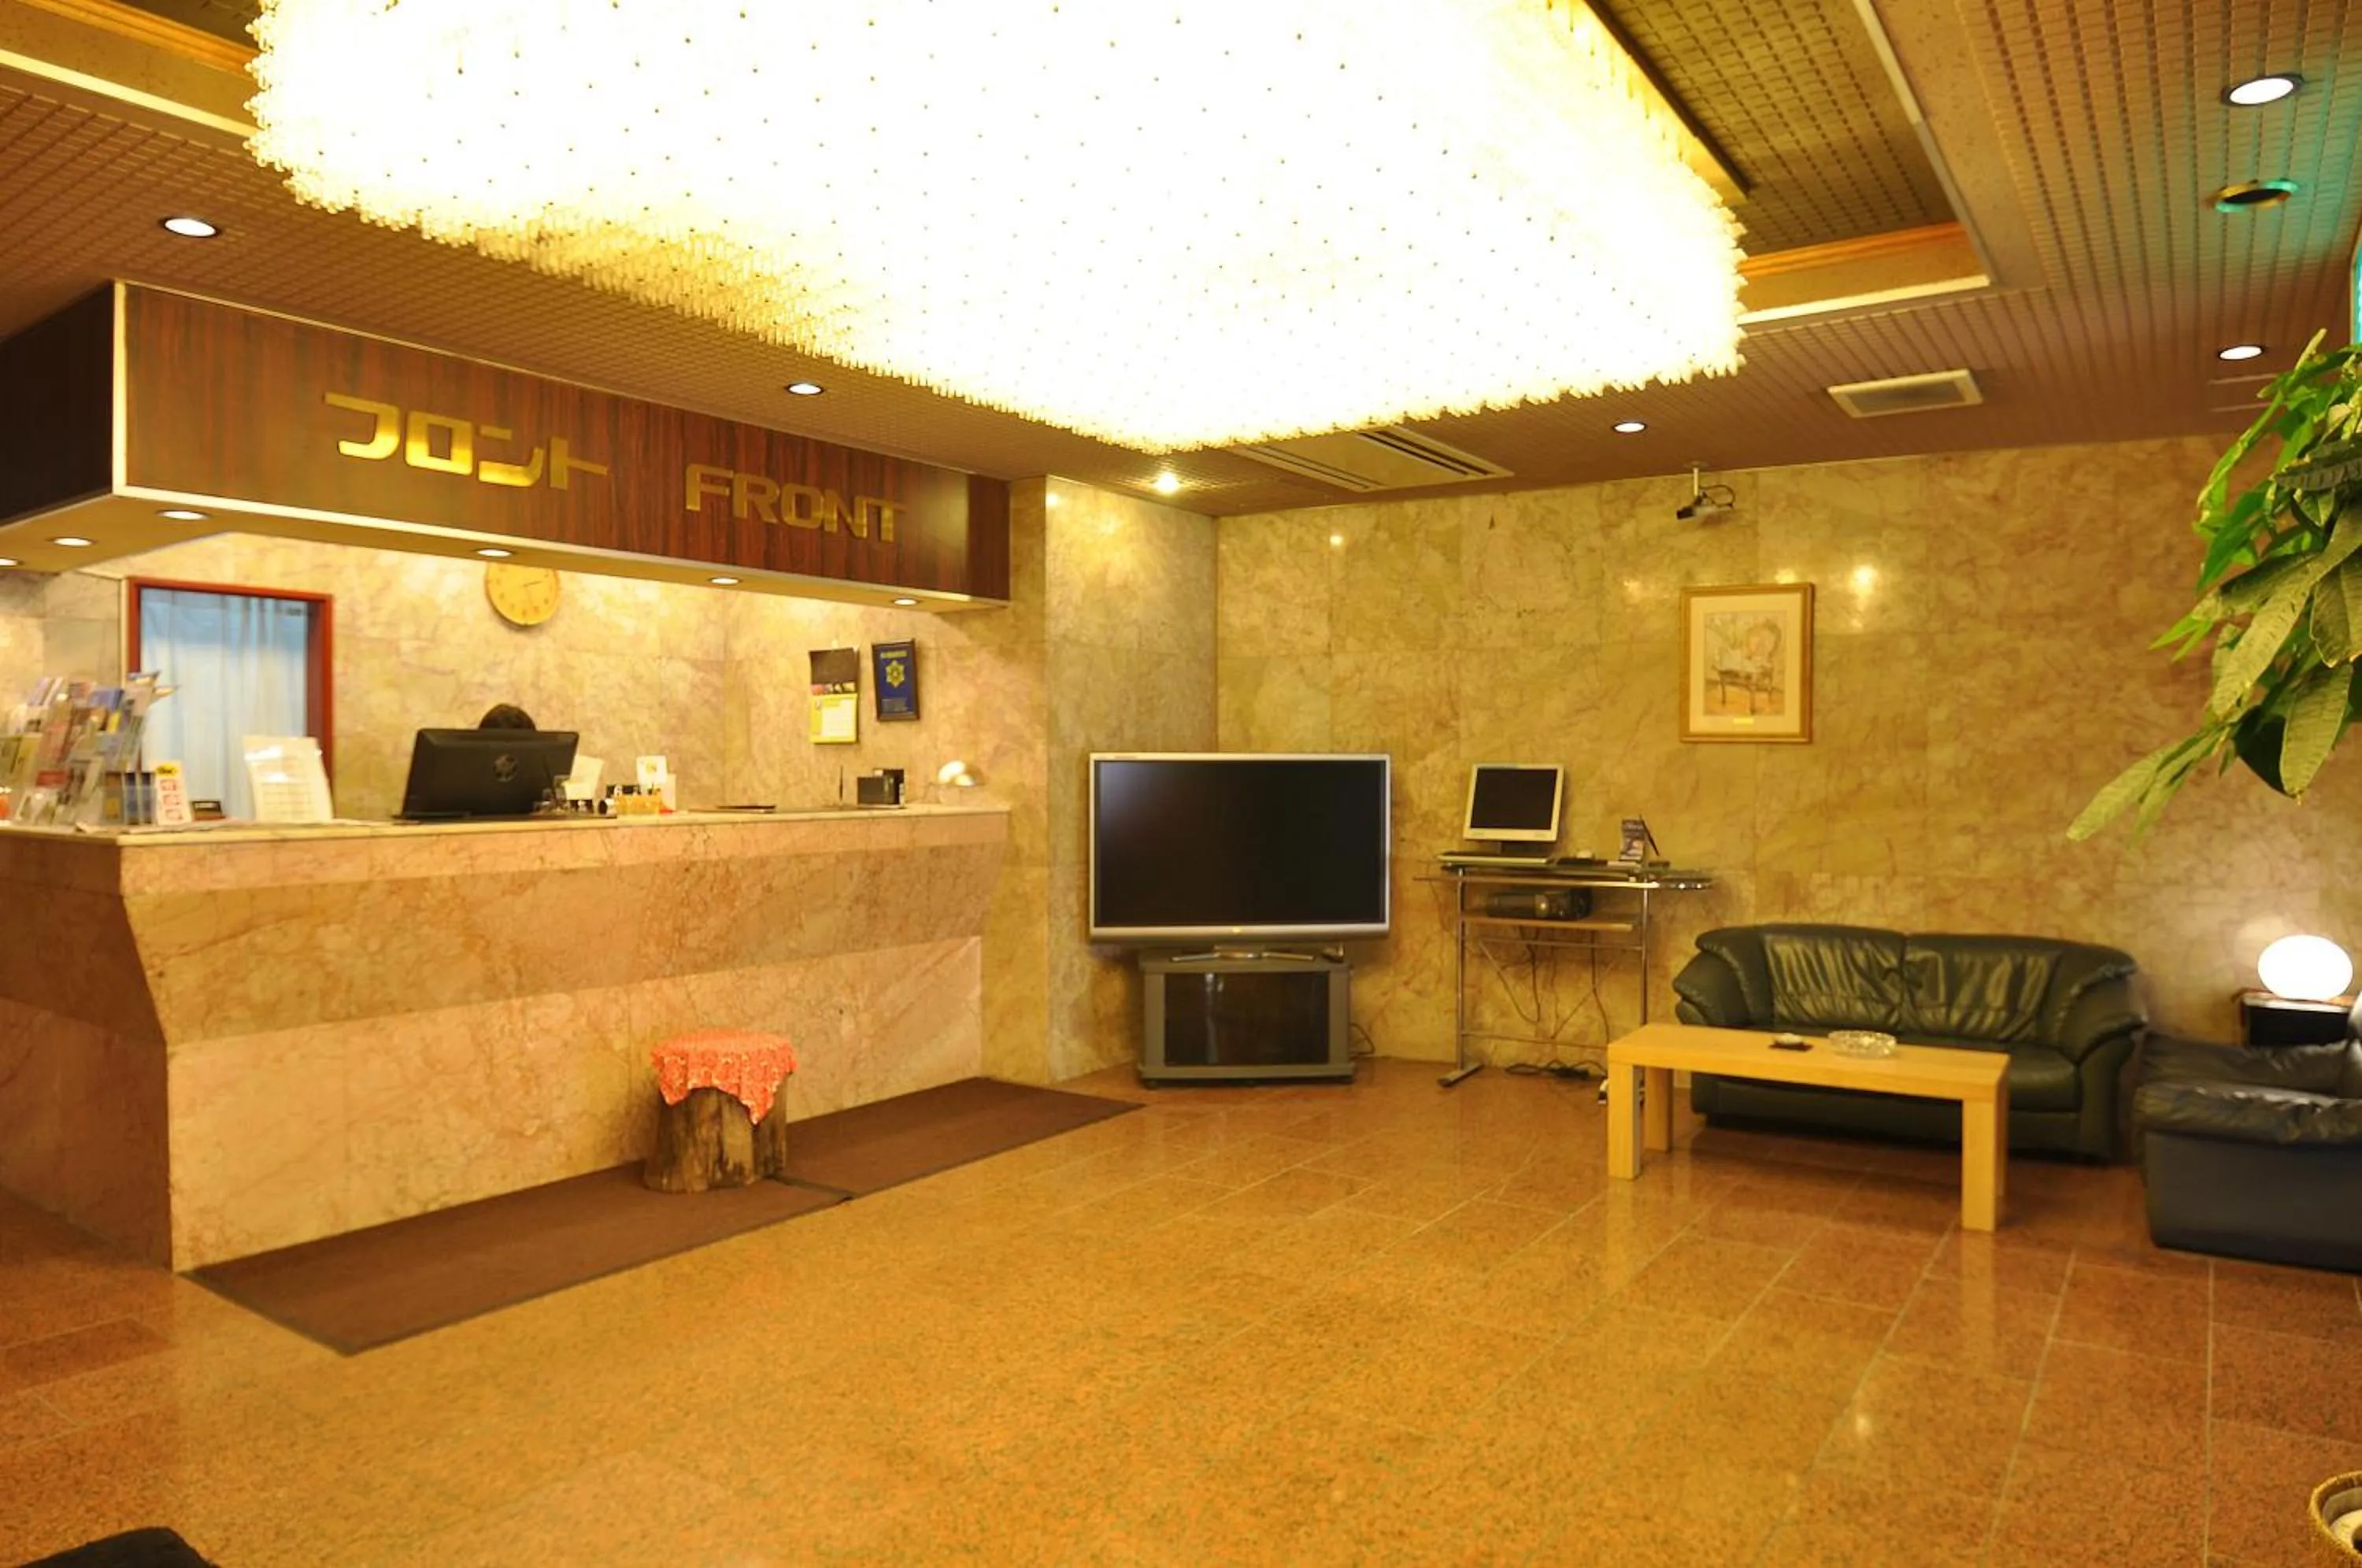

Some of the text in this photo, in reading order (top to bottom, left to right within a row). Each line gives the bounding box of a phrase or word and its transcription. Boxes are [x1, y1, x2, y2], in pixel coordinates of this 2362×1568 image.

[324, 392, 608, 490] フロント
[686, 463, 905, 542] FRONT
